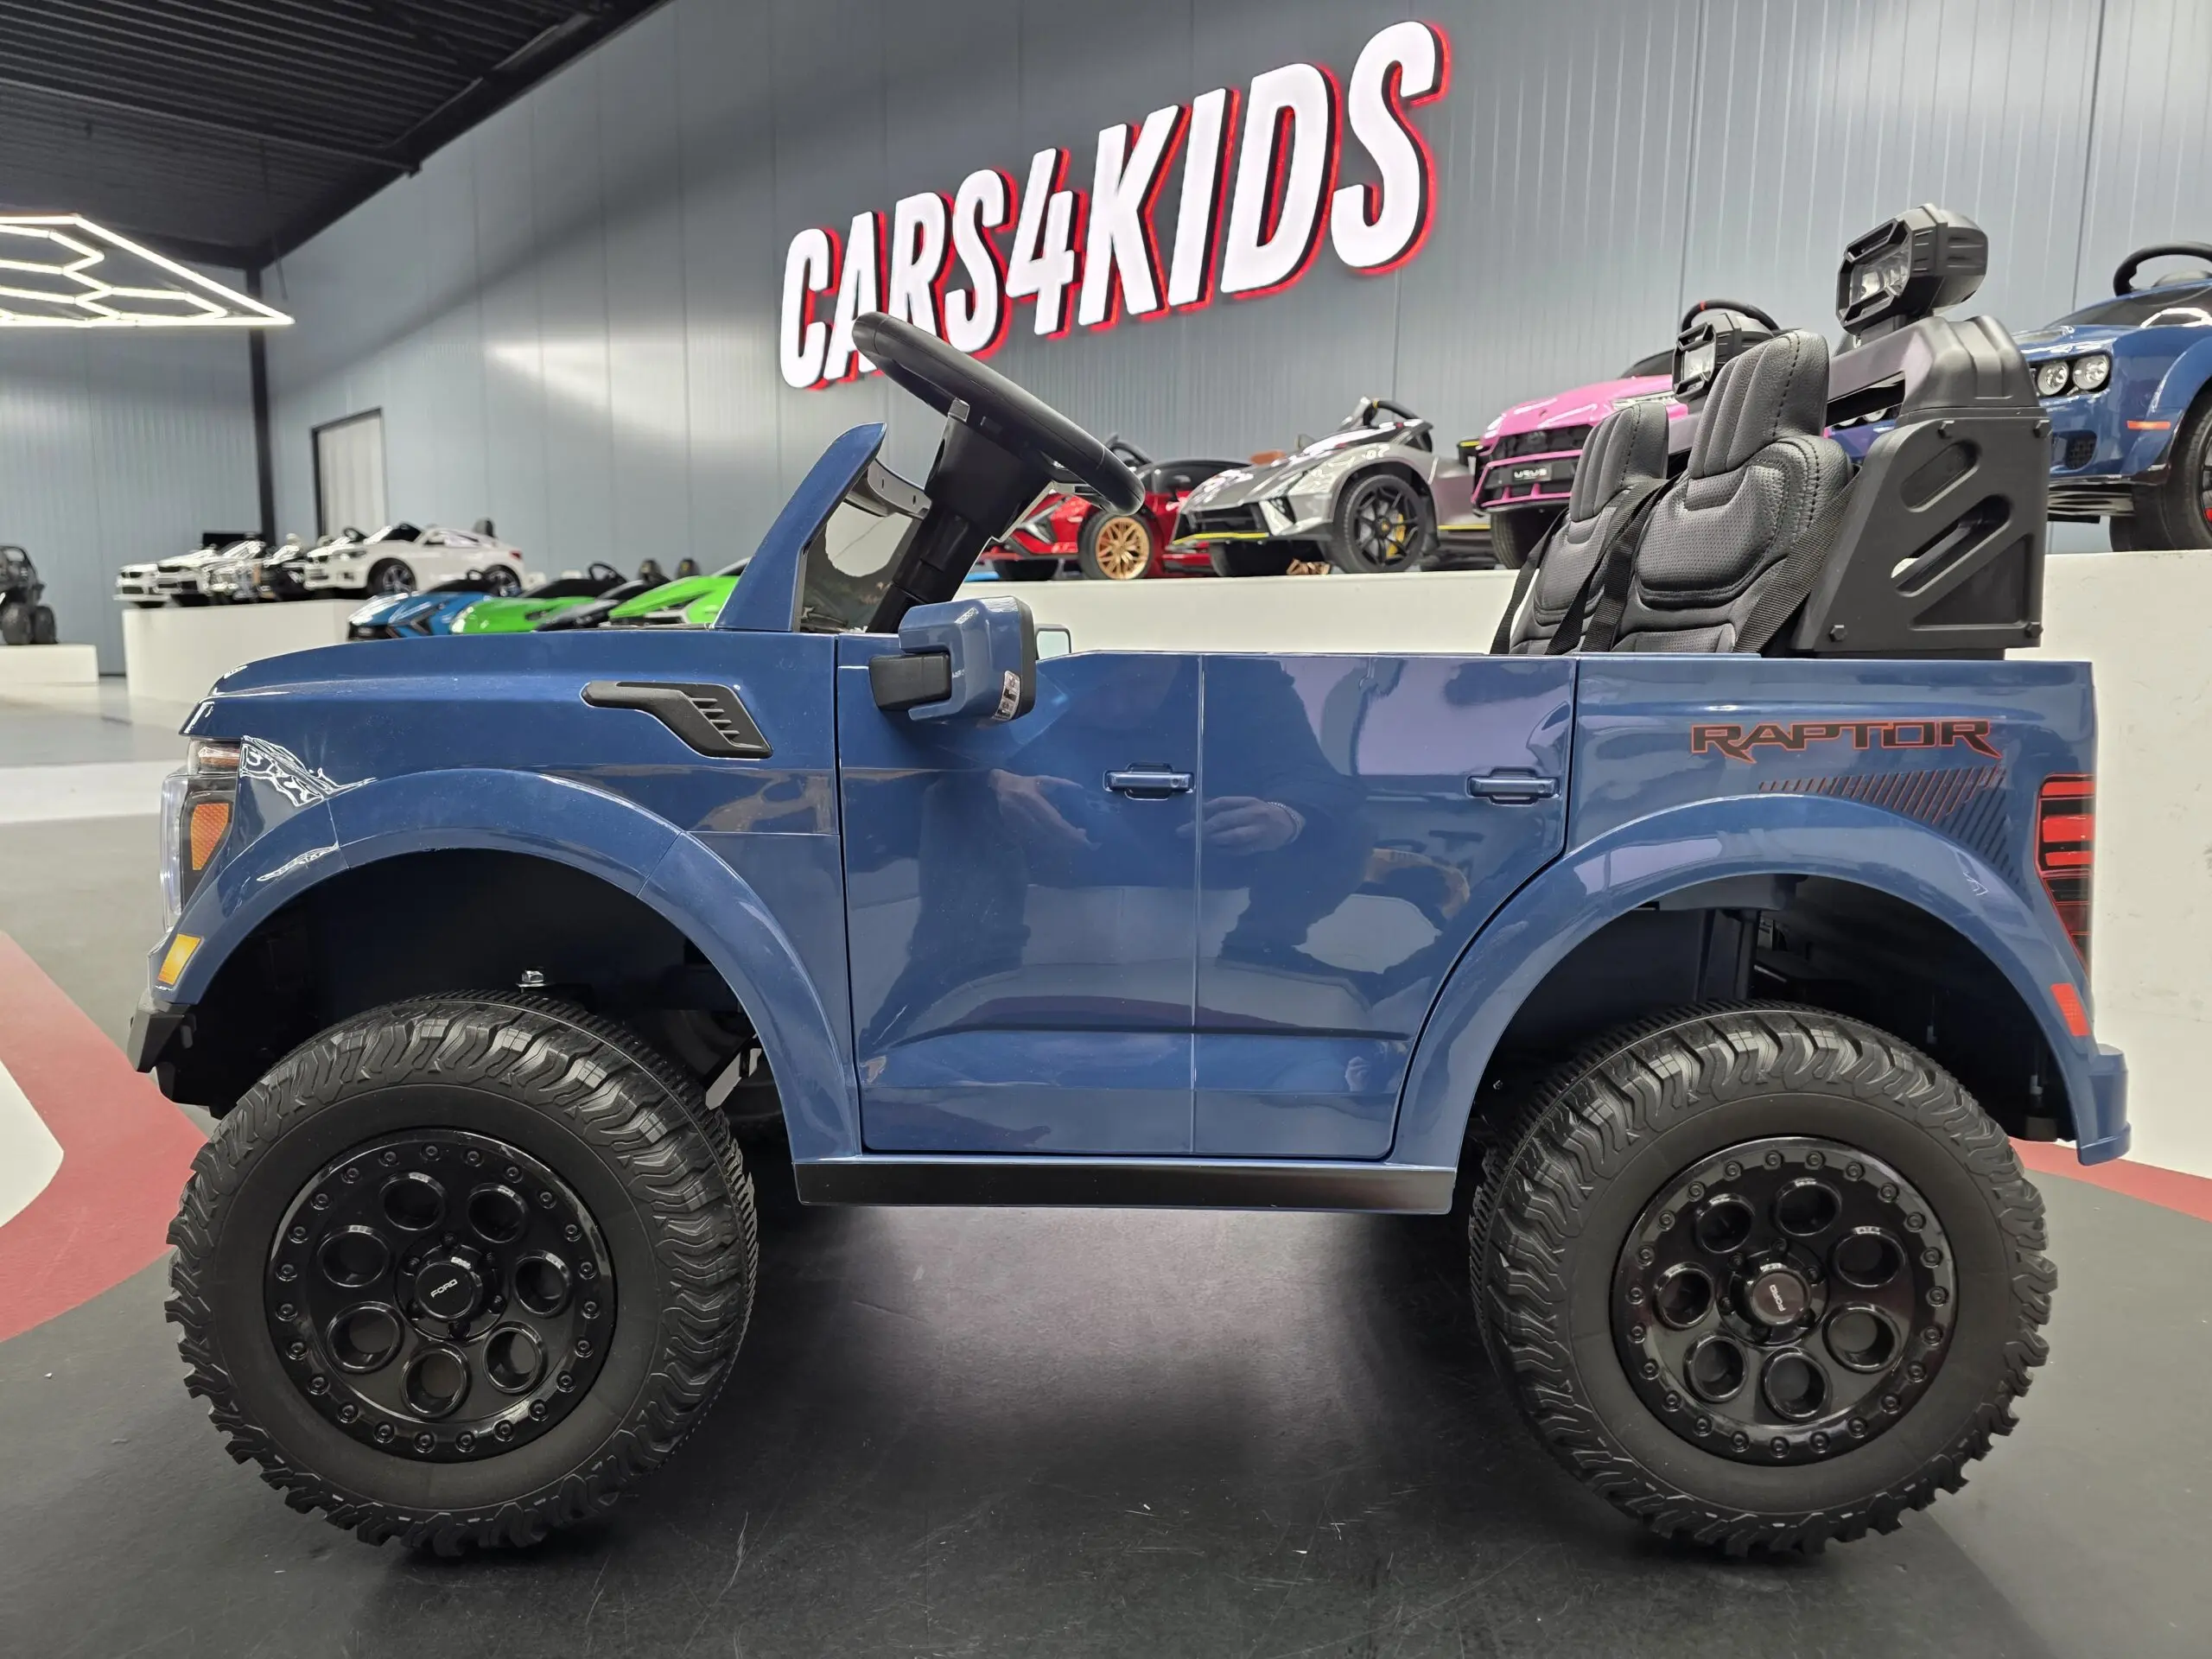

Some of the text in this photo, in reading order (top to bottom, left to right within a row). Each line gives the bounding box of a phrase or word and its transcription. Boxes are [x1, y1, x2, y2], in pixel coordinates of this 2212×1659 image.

[779, 21, 1440, 390] CARS4KIDS
[1691, 719, 2004, 765] RAPTOR
[430, 1279, 458, 1299] FORD
[1769, 1284, 1787, 1312] FORD
